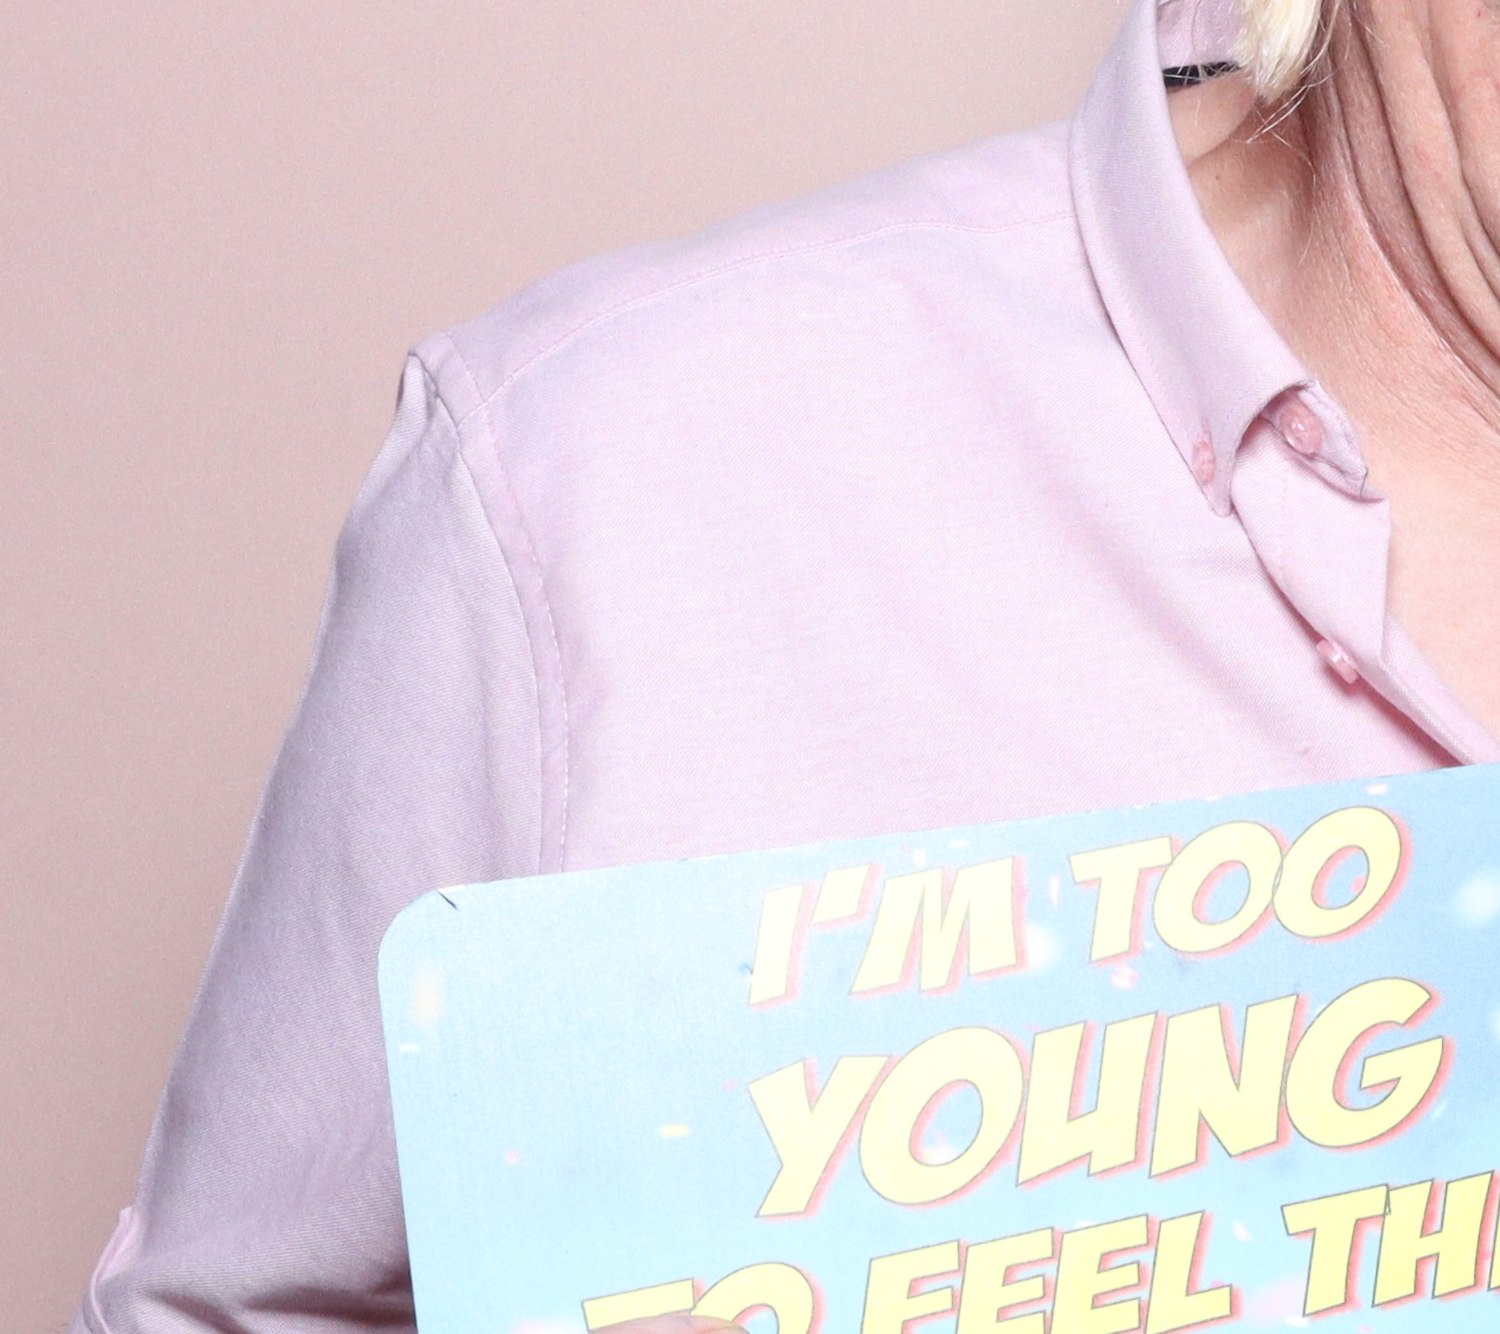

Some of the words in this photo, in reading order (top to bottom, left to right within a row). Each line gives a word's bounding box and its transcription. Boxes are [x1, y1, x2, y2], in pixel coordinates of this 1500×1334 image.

[748, 853, 1026, 1009] I'M
[1070, 804, 1405, 967] TOO
[748, 977, 1450, 1220] YOUNG
